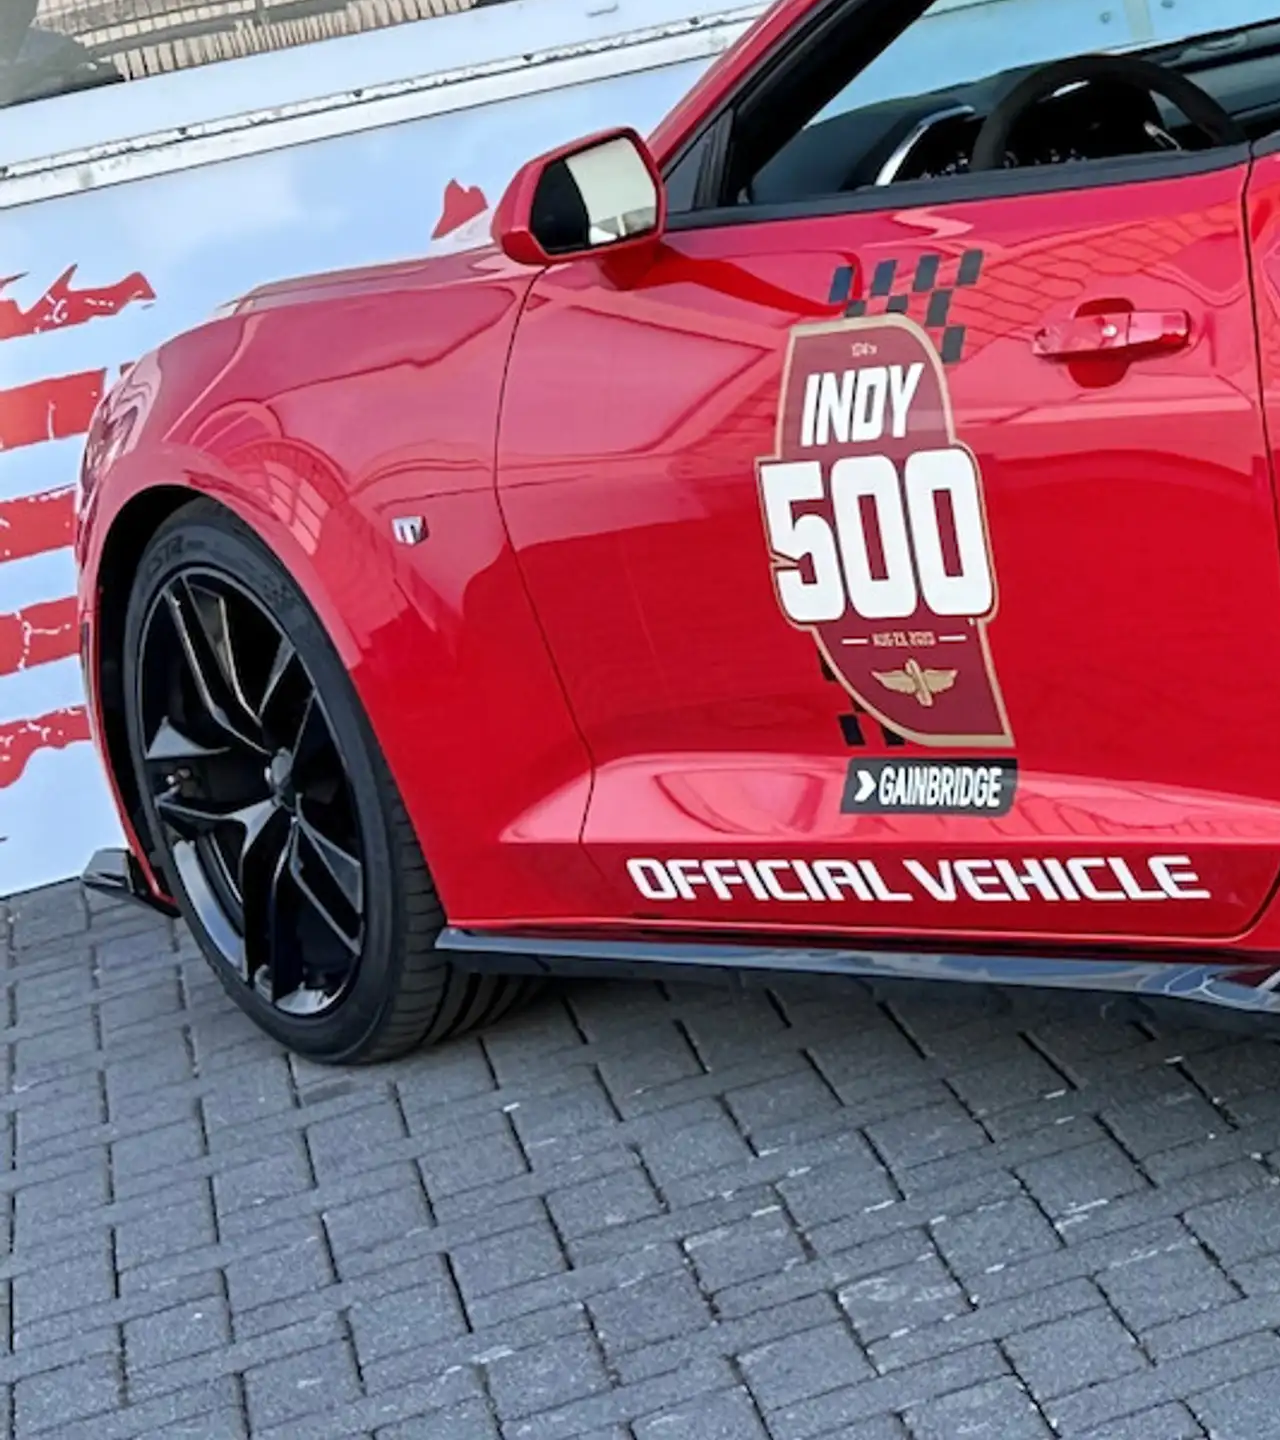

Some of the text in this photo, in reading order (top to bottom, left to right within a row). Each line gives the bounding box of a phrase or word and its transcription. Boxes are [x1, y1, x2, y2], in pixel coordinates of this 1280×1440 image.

[801, 362, 925, 448] INDY
[759, 447, 995, 622] 500
[877, 766, 1003, 808] GAINBRIDGE
[626, 855, 1211, 903] OFFICIAL VEHICLE
